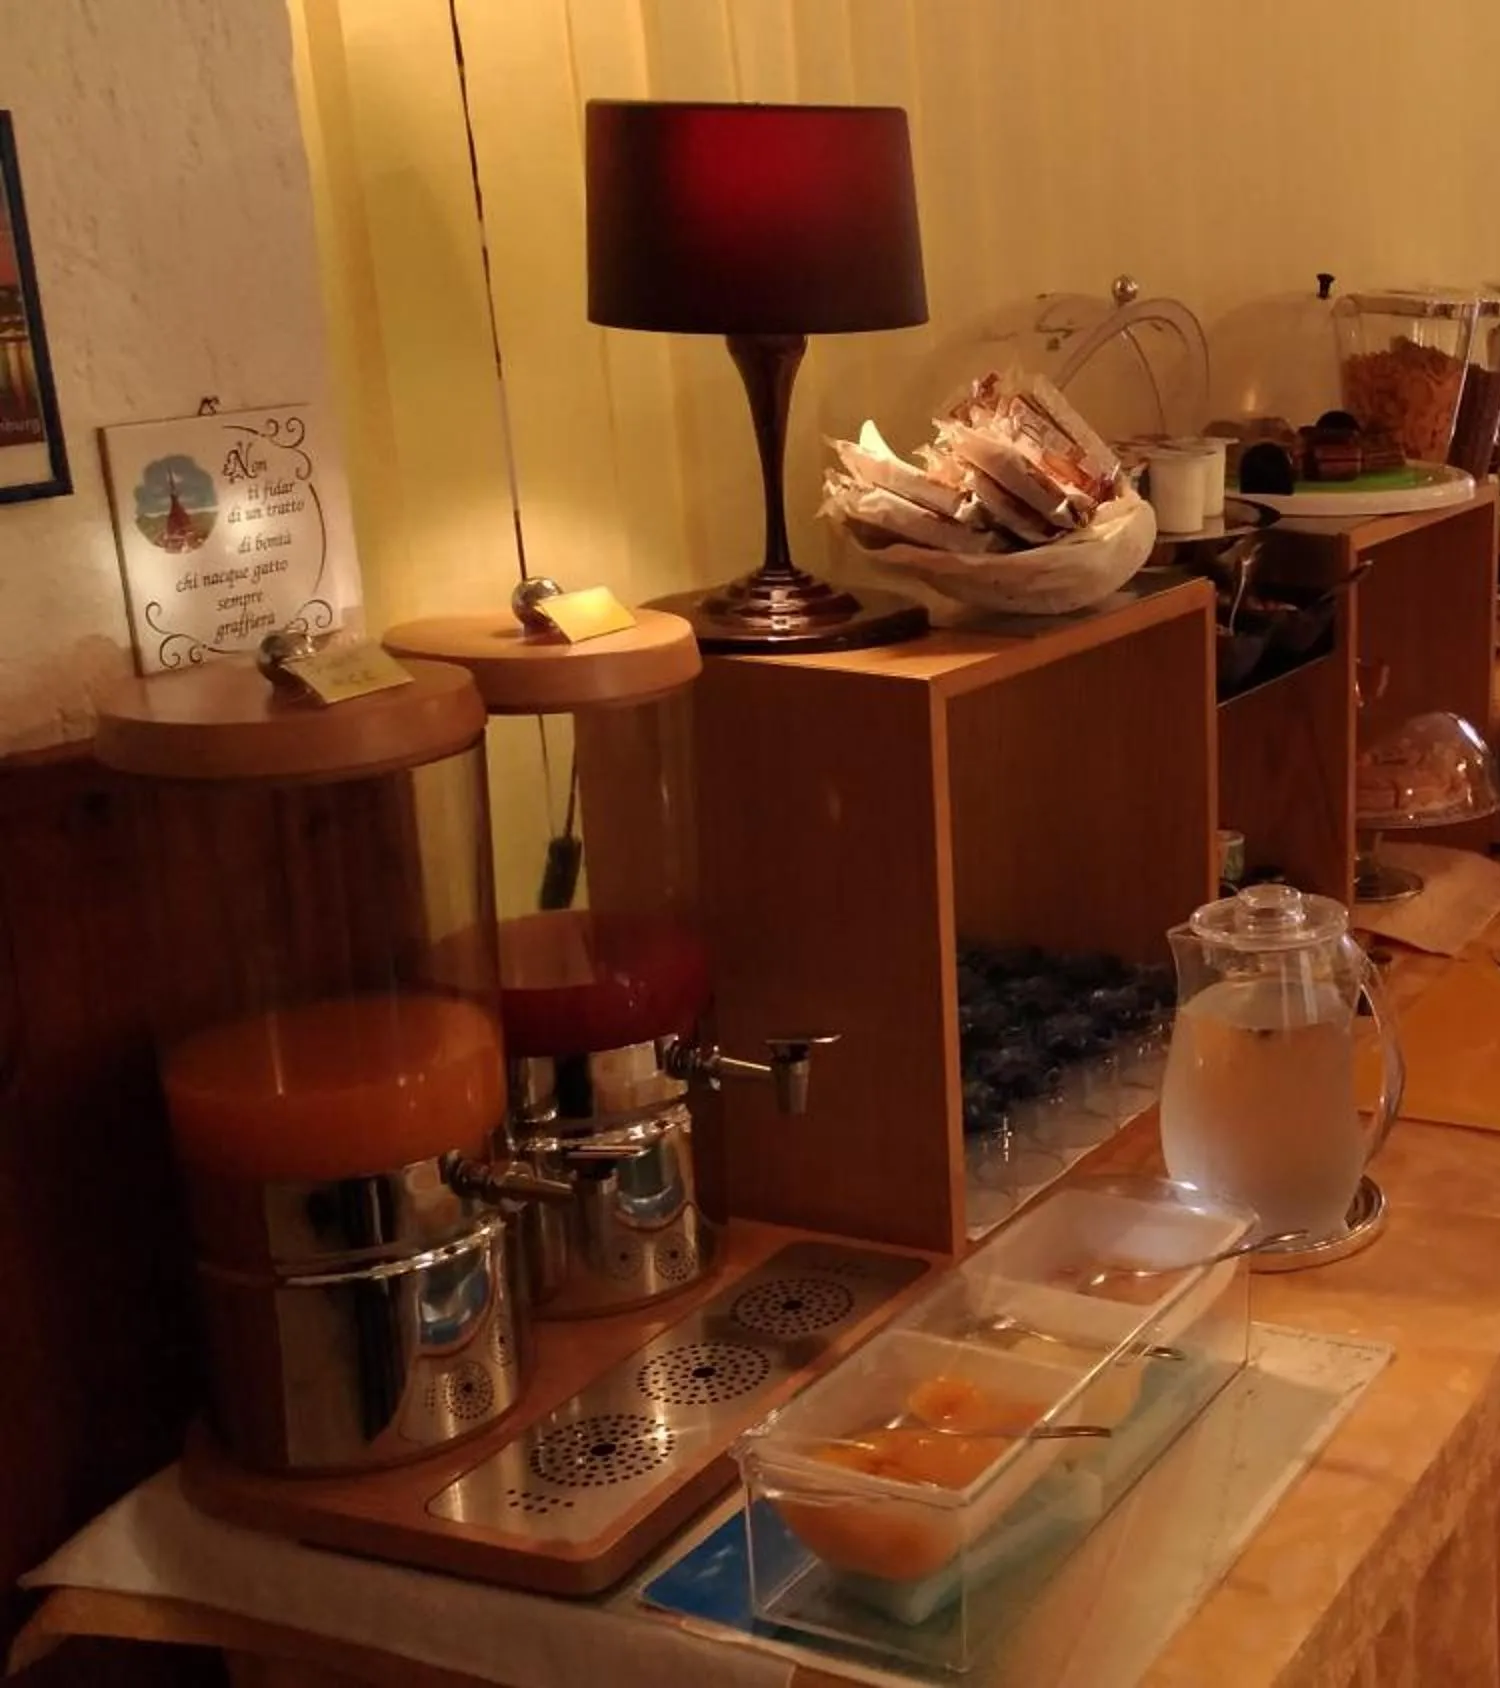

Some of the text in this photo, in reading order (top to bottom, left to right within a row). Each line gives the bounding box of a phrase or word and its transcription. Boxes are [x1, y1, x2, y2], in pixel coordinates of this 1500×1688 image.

[222, 441, 267, 484] Non
[248, 479, 296, 503] ti fidar
[227, 499, 305, 523] di un tratto
[238, 535, 251, 554] di
[176, 559, 288, 593] chi nacque gatto
[216, 591, 264, 612] sempre
